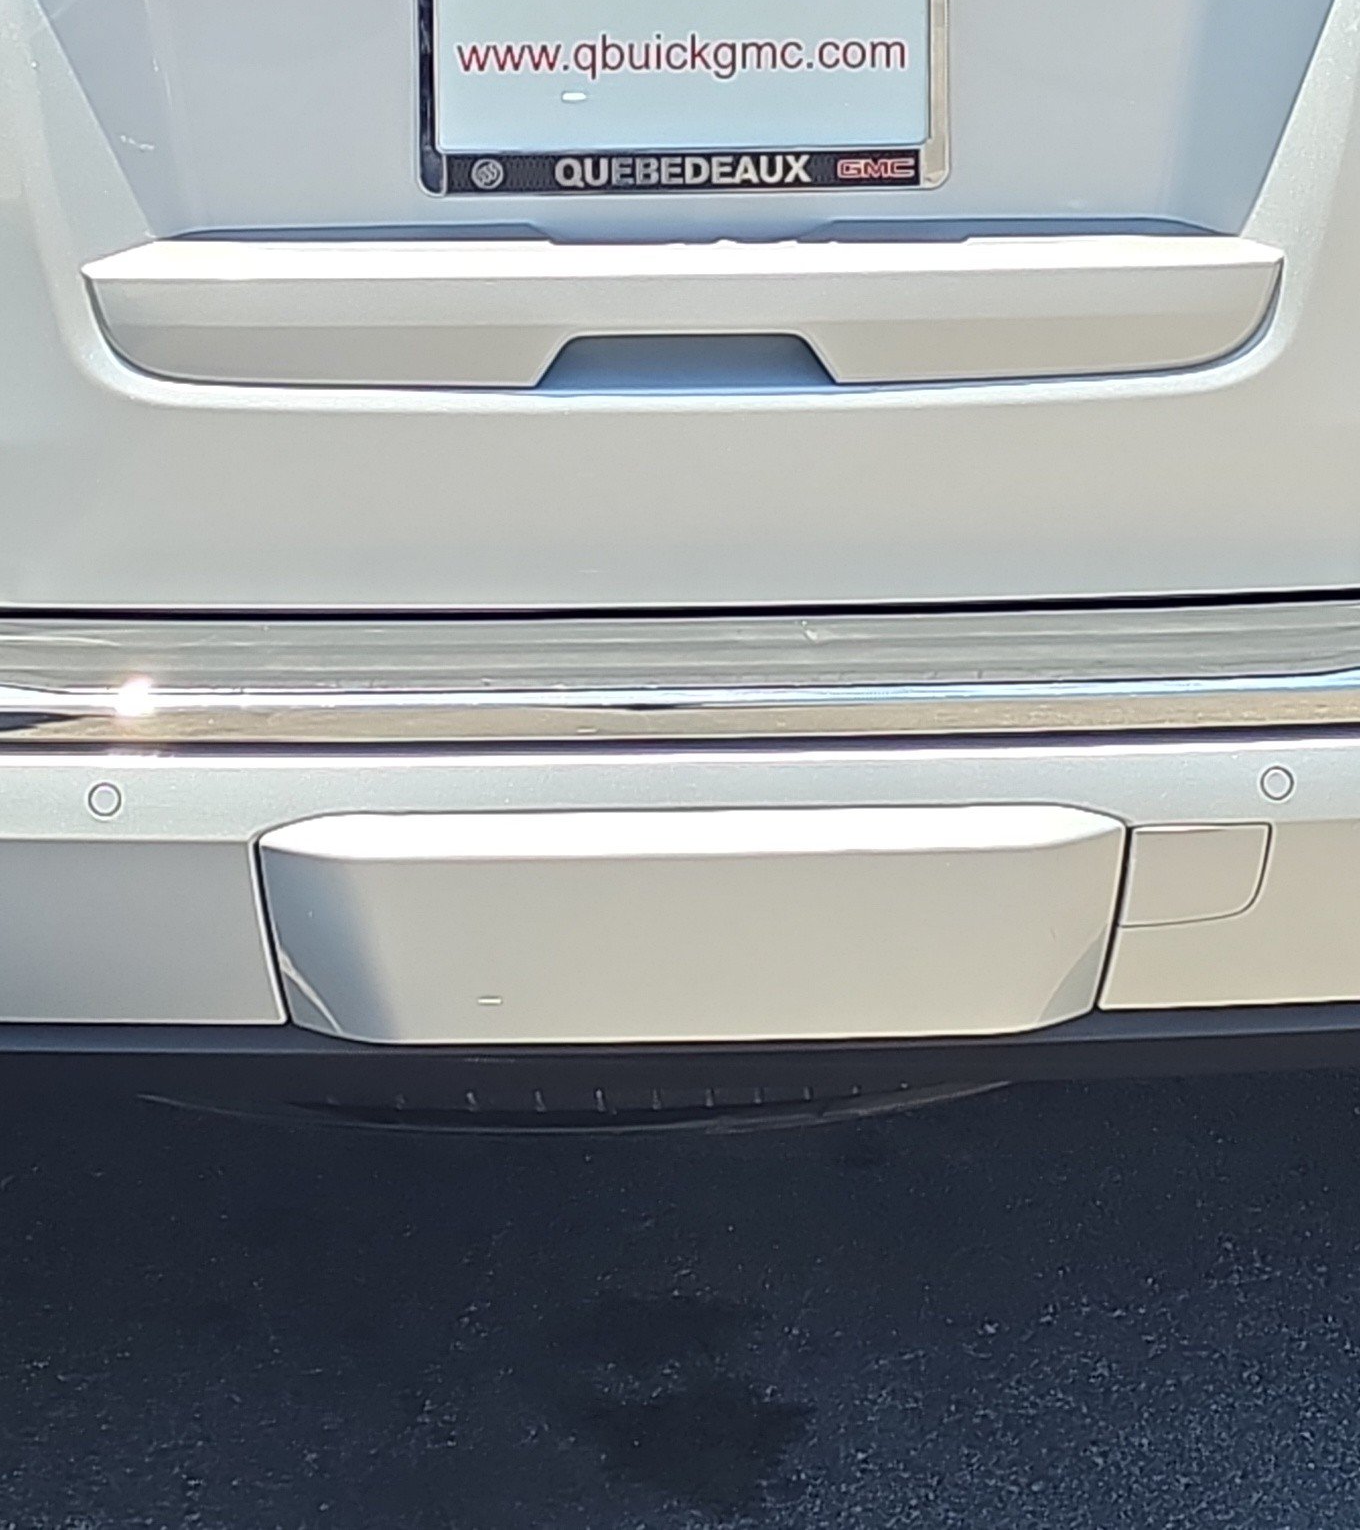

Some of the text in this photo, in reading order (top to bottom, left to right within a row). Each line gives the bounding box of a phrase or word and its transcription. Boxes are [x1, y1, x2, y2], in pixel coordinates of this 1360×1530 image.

[455, 33, 907, 80] www.qbuickgmc.com
[554, 155, 916, 188] QUEBEDEAUX GMC
